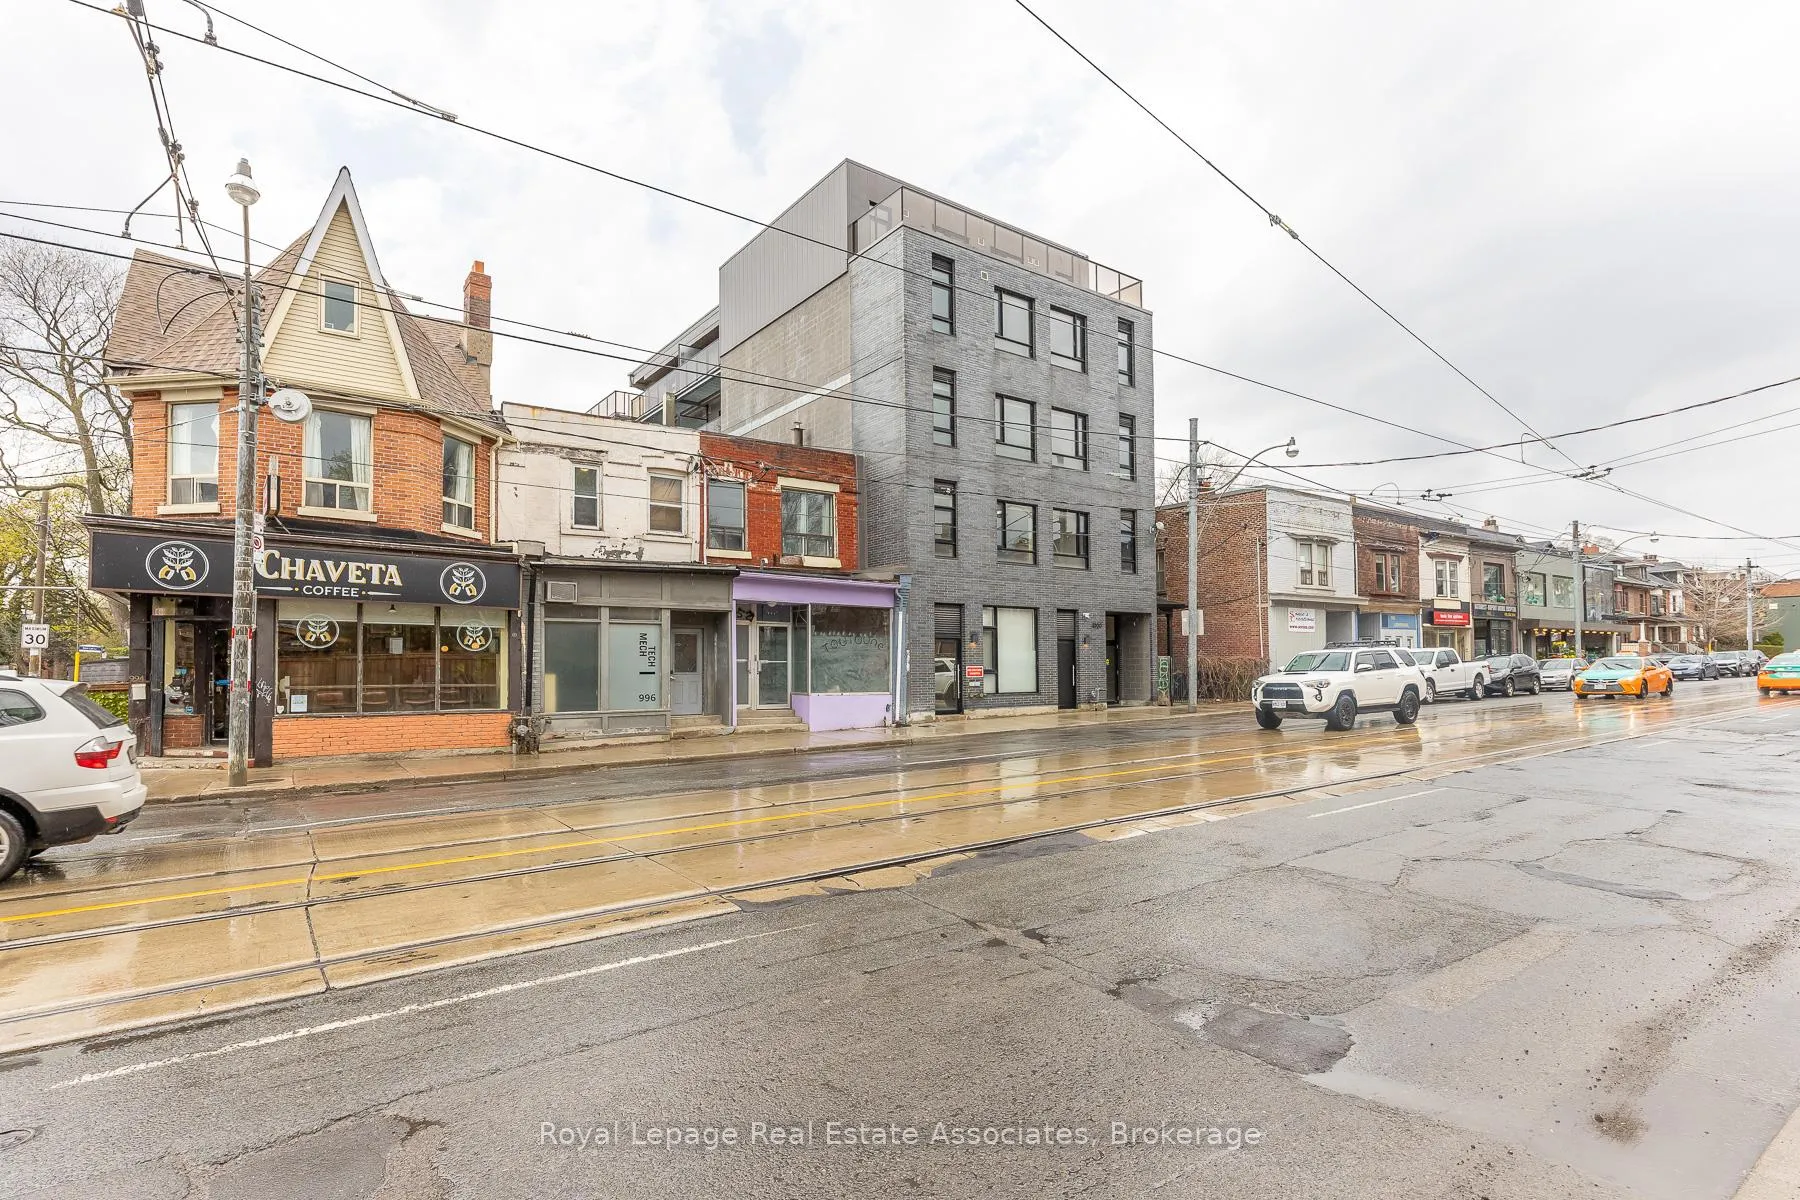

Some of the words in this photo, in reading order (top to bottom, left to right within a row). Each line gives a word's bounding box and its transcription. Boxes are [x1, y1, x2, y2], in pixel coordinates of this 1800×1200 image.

[255, 549, 403, 586] CHAVETA
[302, 585, 359, 597] COFFEE
[24, 633, 46, 645] 30
[639, 632, 648, 657] MECH
[647, 645, 656, 667] TECH
[638, 693, 656, 702] 996
